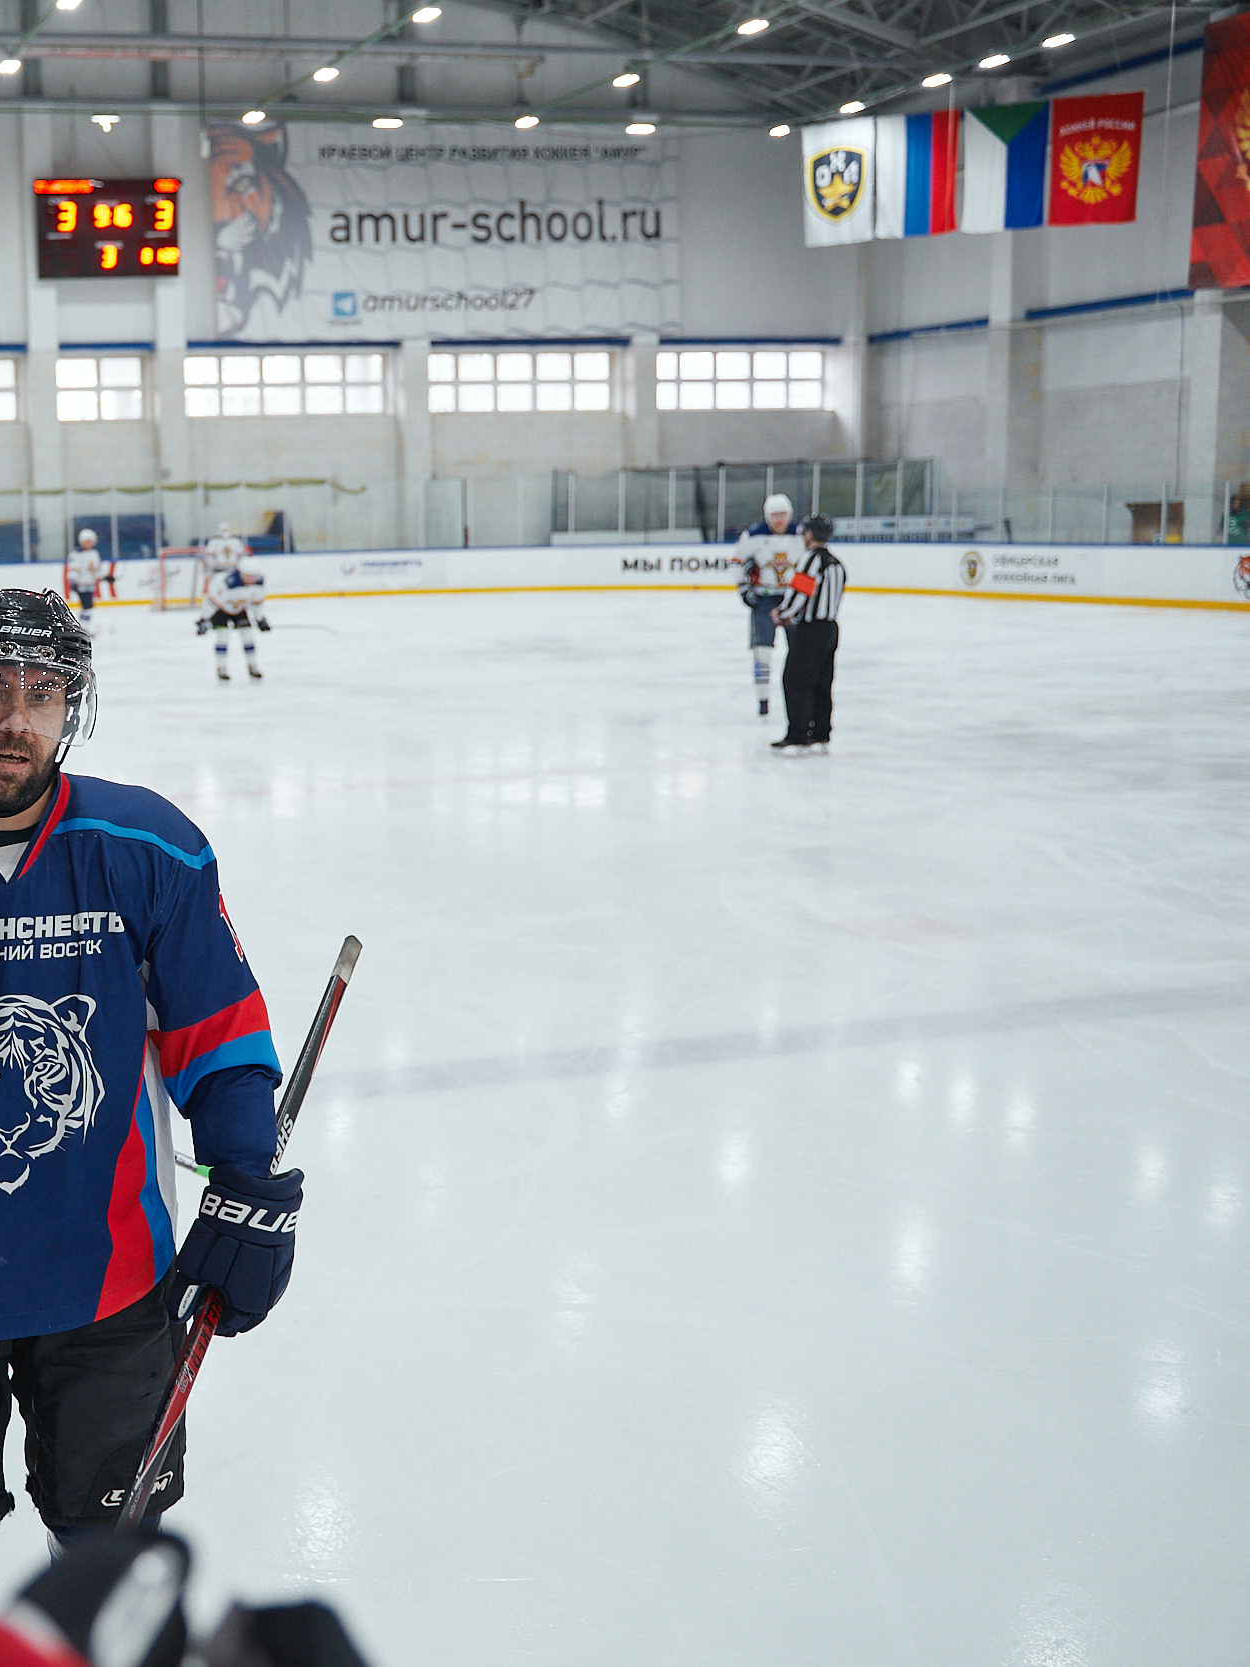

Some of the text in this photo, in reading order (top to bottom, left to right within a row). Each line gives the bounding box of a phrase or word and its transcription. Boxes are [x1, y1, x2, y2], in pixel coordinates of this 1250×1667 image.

[56, 200, 78, 232] 3
[153, 199, 175, 231] 3
[329, 200, 662, 244] amur-school.ru
[622, 558, 661, 571] МЫ
[0, 625, 53, 638] BAUER
